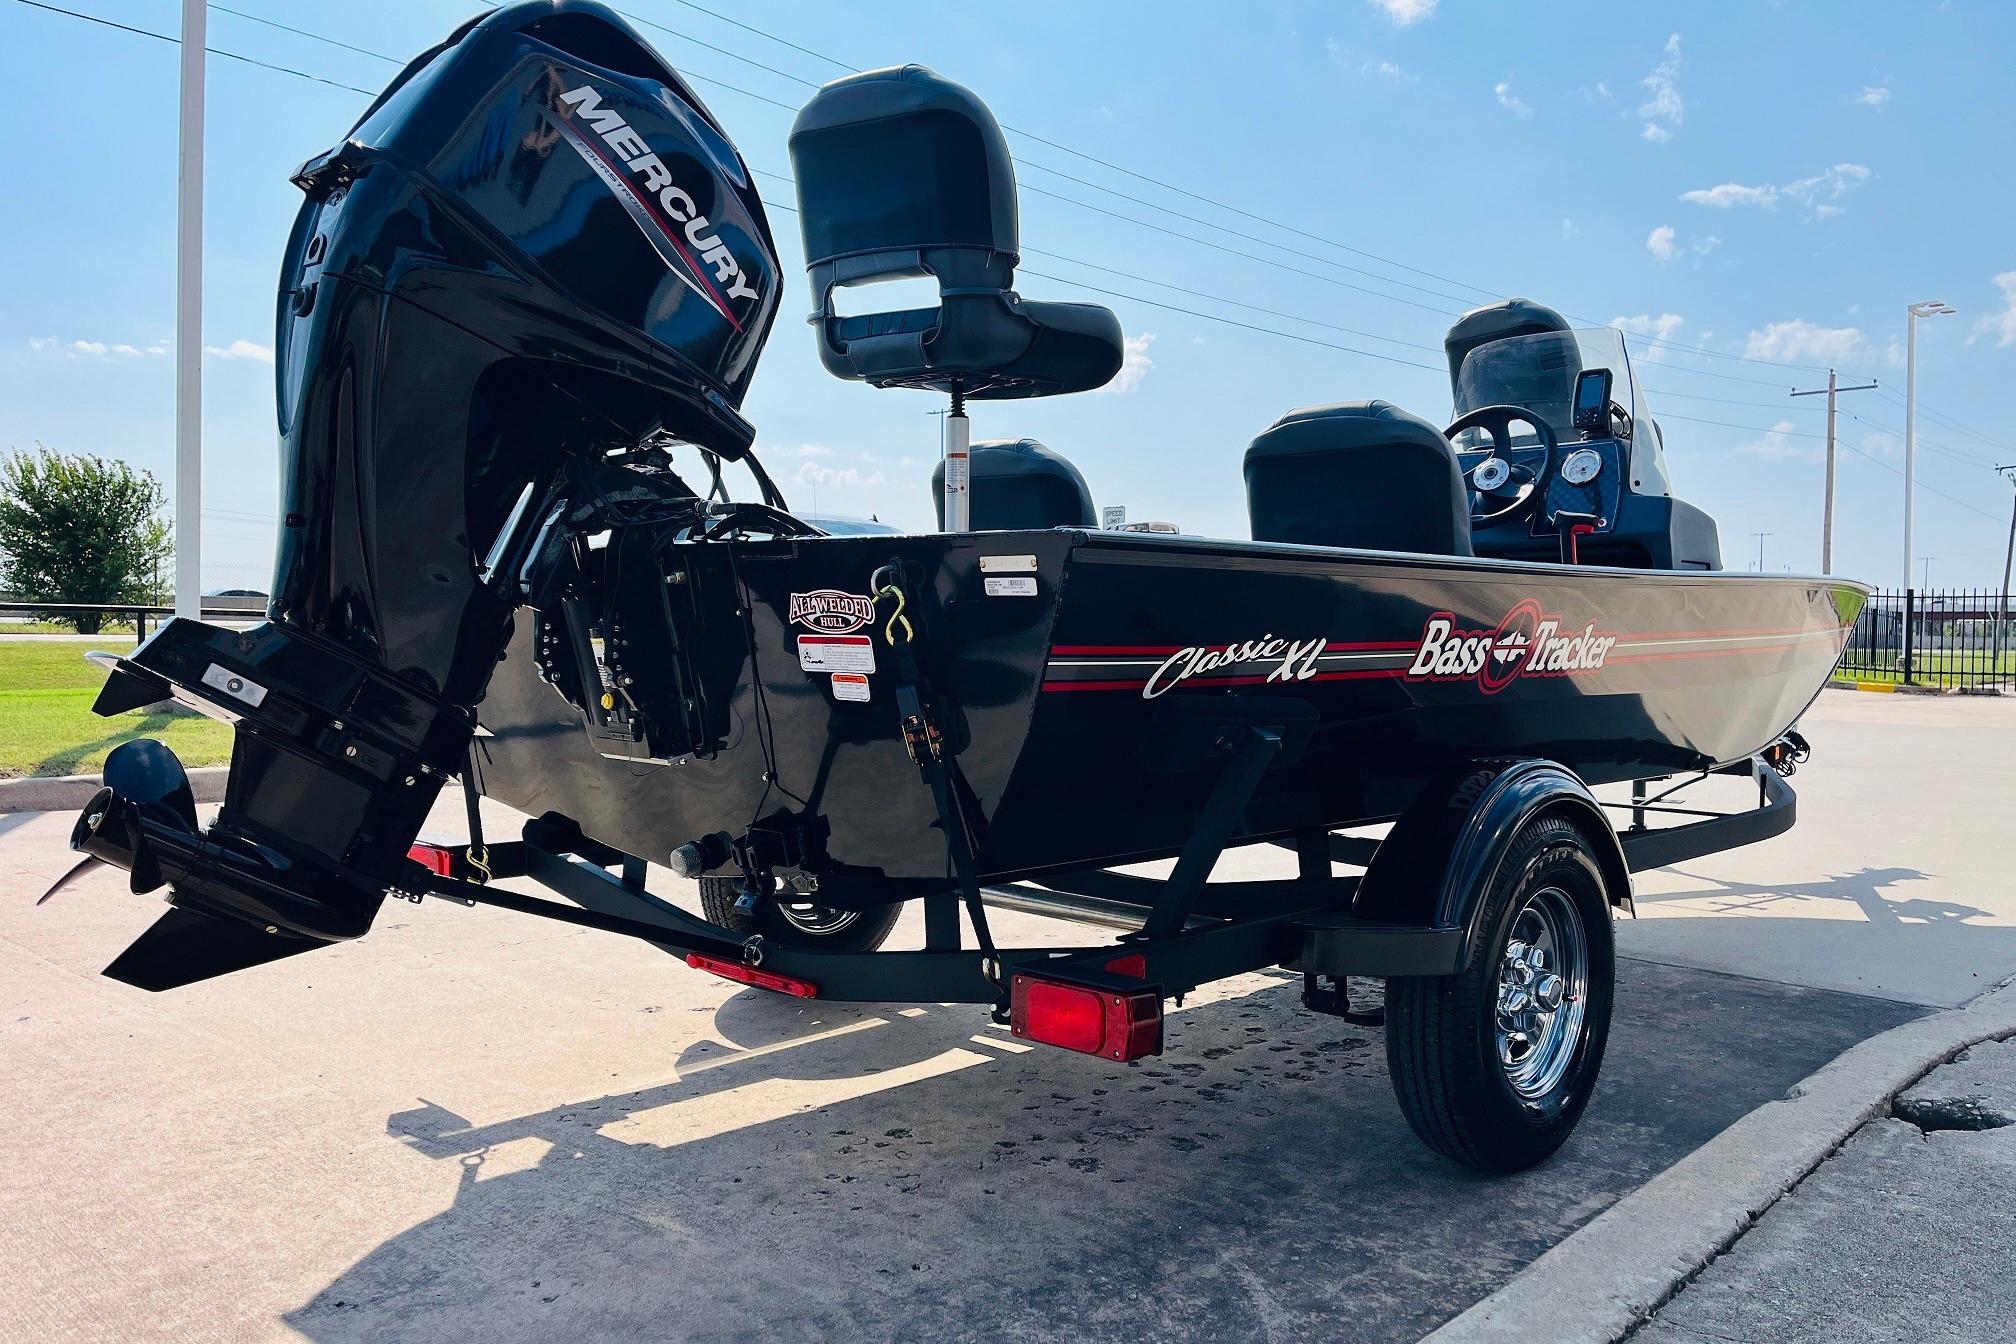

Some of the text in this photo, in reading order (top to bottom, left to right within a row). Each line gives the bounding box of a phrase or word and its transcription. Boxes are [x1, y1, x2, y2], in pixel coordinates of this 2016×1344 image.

[560, 85, 759, 300] MERCURY
[815, 598, 872, 620] WELDED
[819, 617, 845, 627] HULL
[1142, 633, 1327, 699] Classic XL
[1408, 619, 1617, 675] Bass Tracker
